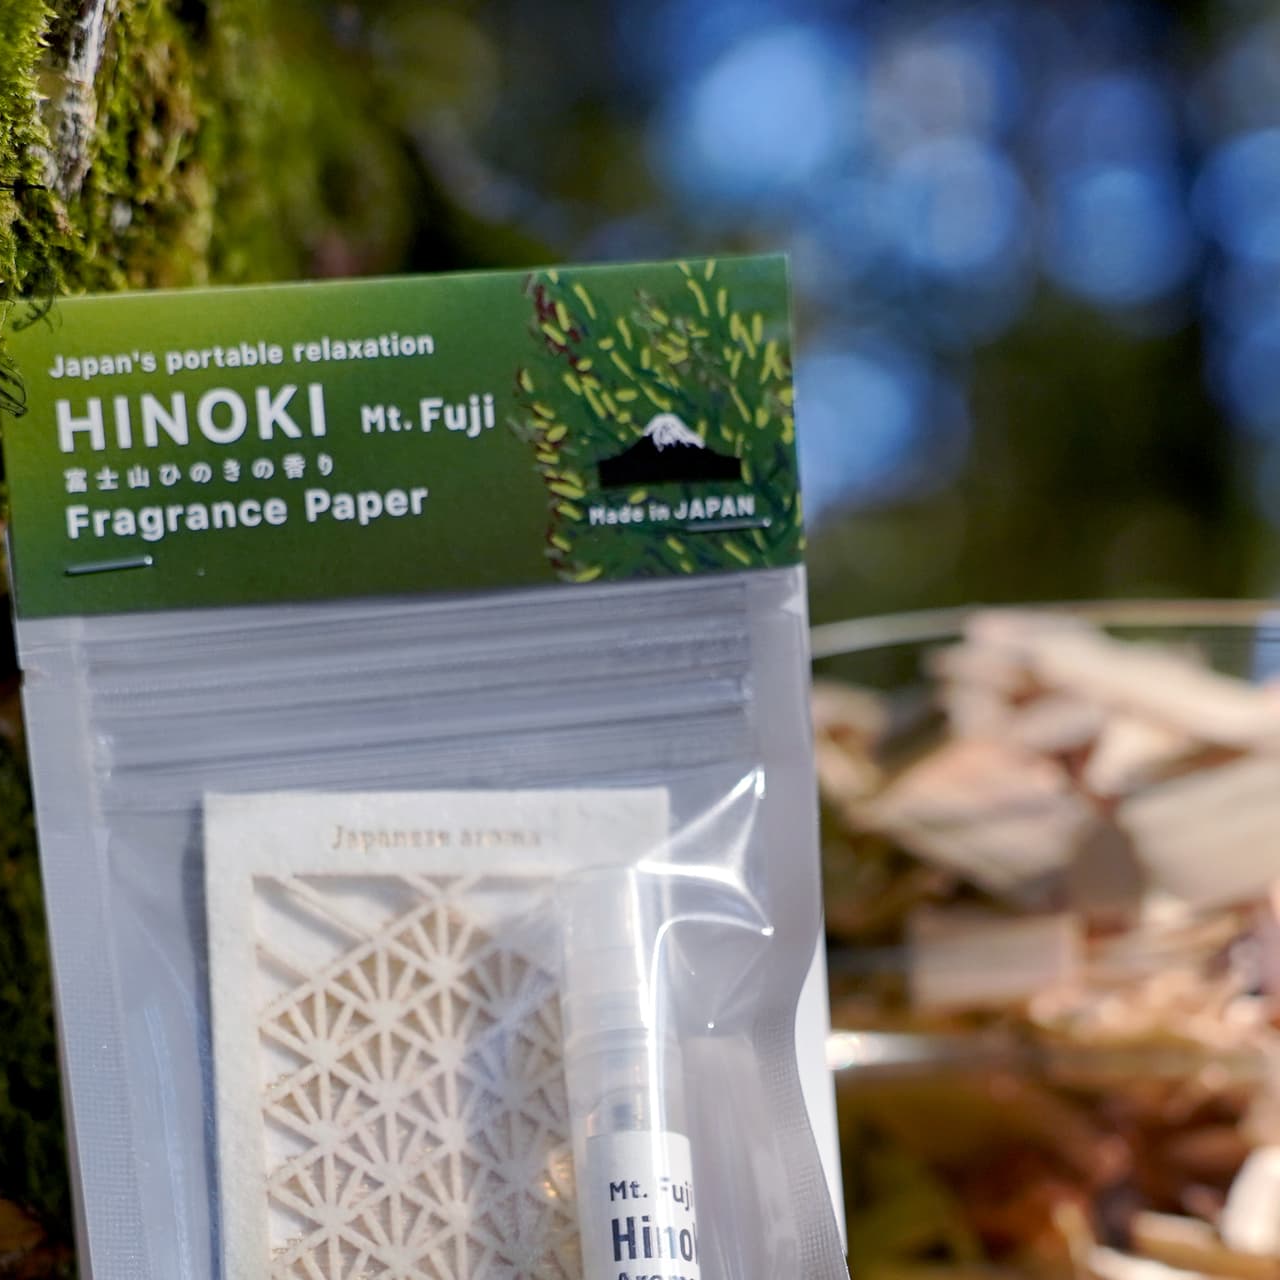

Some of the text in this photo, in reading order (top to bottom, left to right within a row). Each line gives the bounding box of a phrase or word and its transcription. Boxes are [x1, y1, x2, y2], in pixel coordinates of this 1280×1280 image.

[49, 333, 435, 380] Japan's portable relaxation
[56, 384, 495, 453] HINOKI Mt. Fuji
[64, 453, 334, 494] 富士山ひのきの香り
[66, 487, 428, 541] Fragrance Paper
[589, 495, 755, 526] Made in JAPAN
[609, 1180, 648, 1202] Mt.
[612, 1215, 698, 1264] Hino
